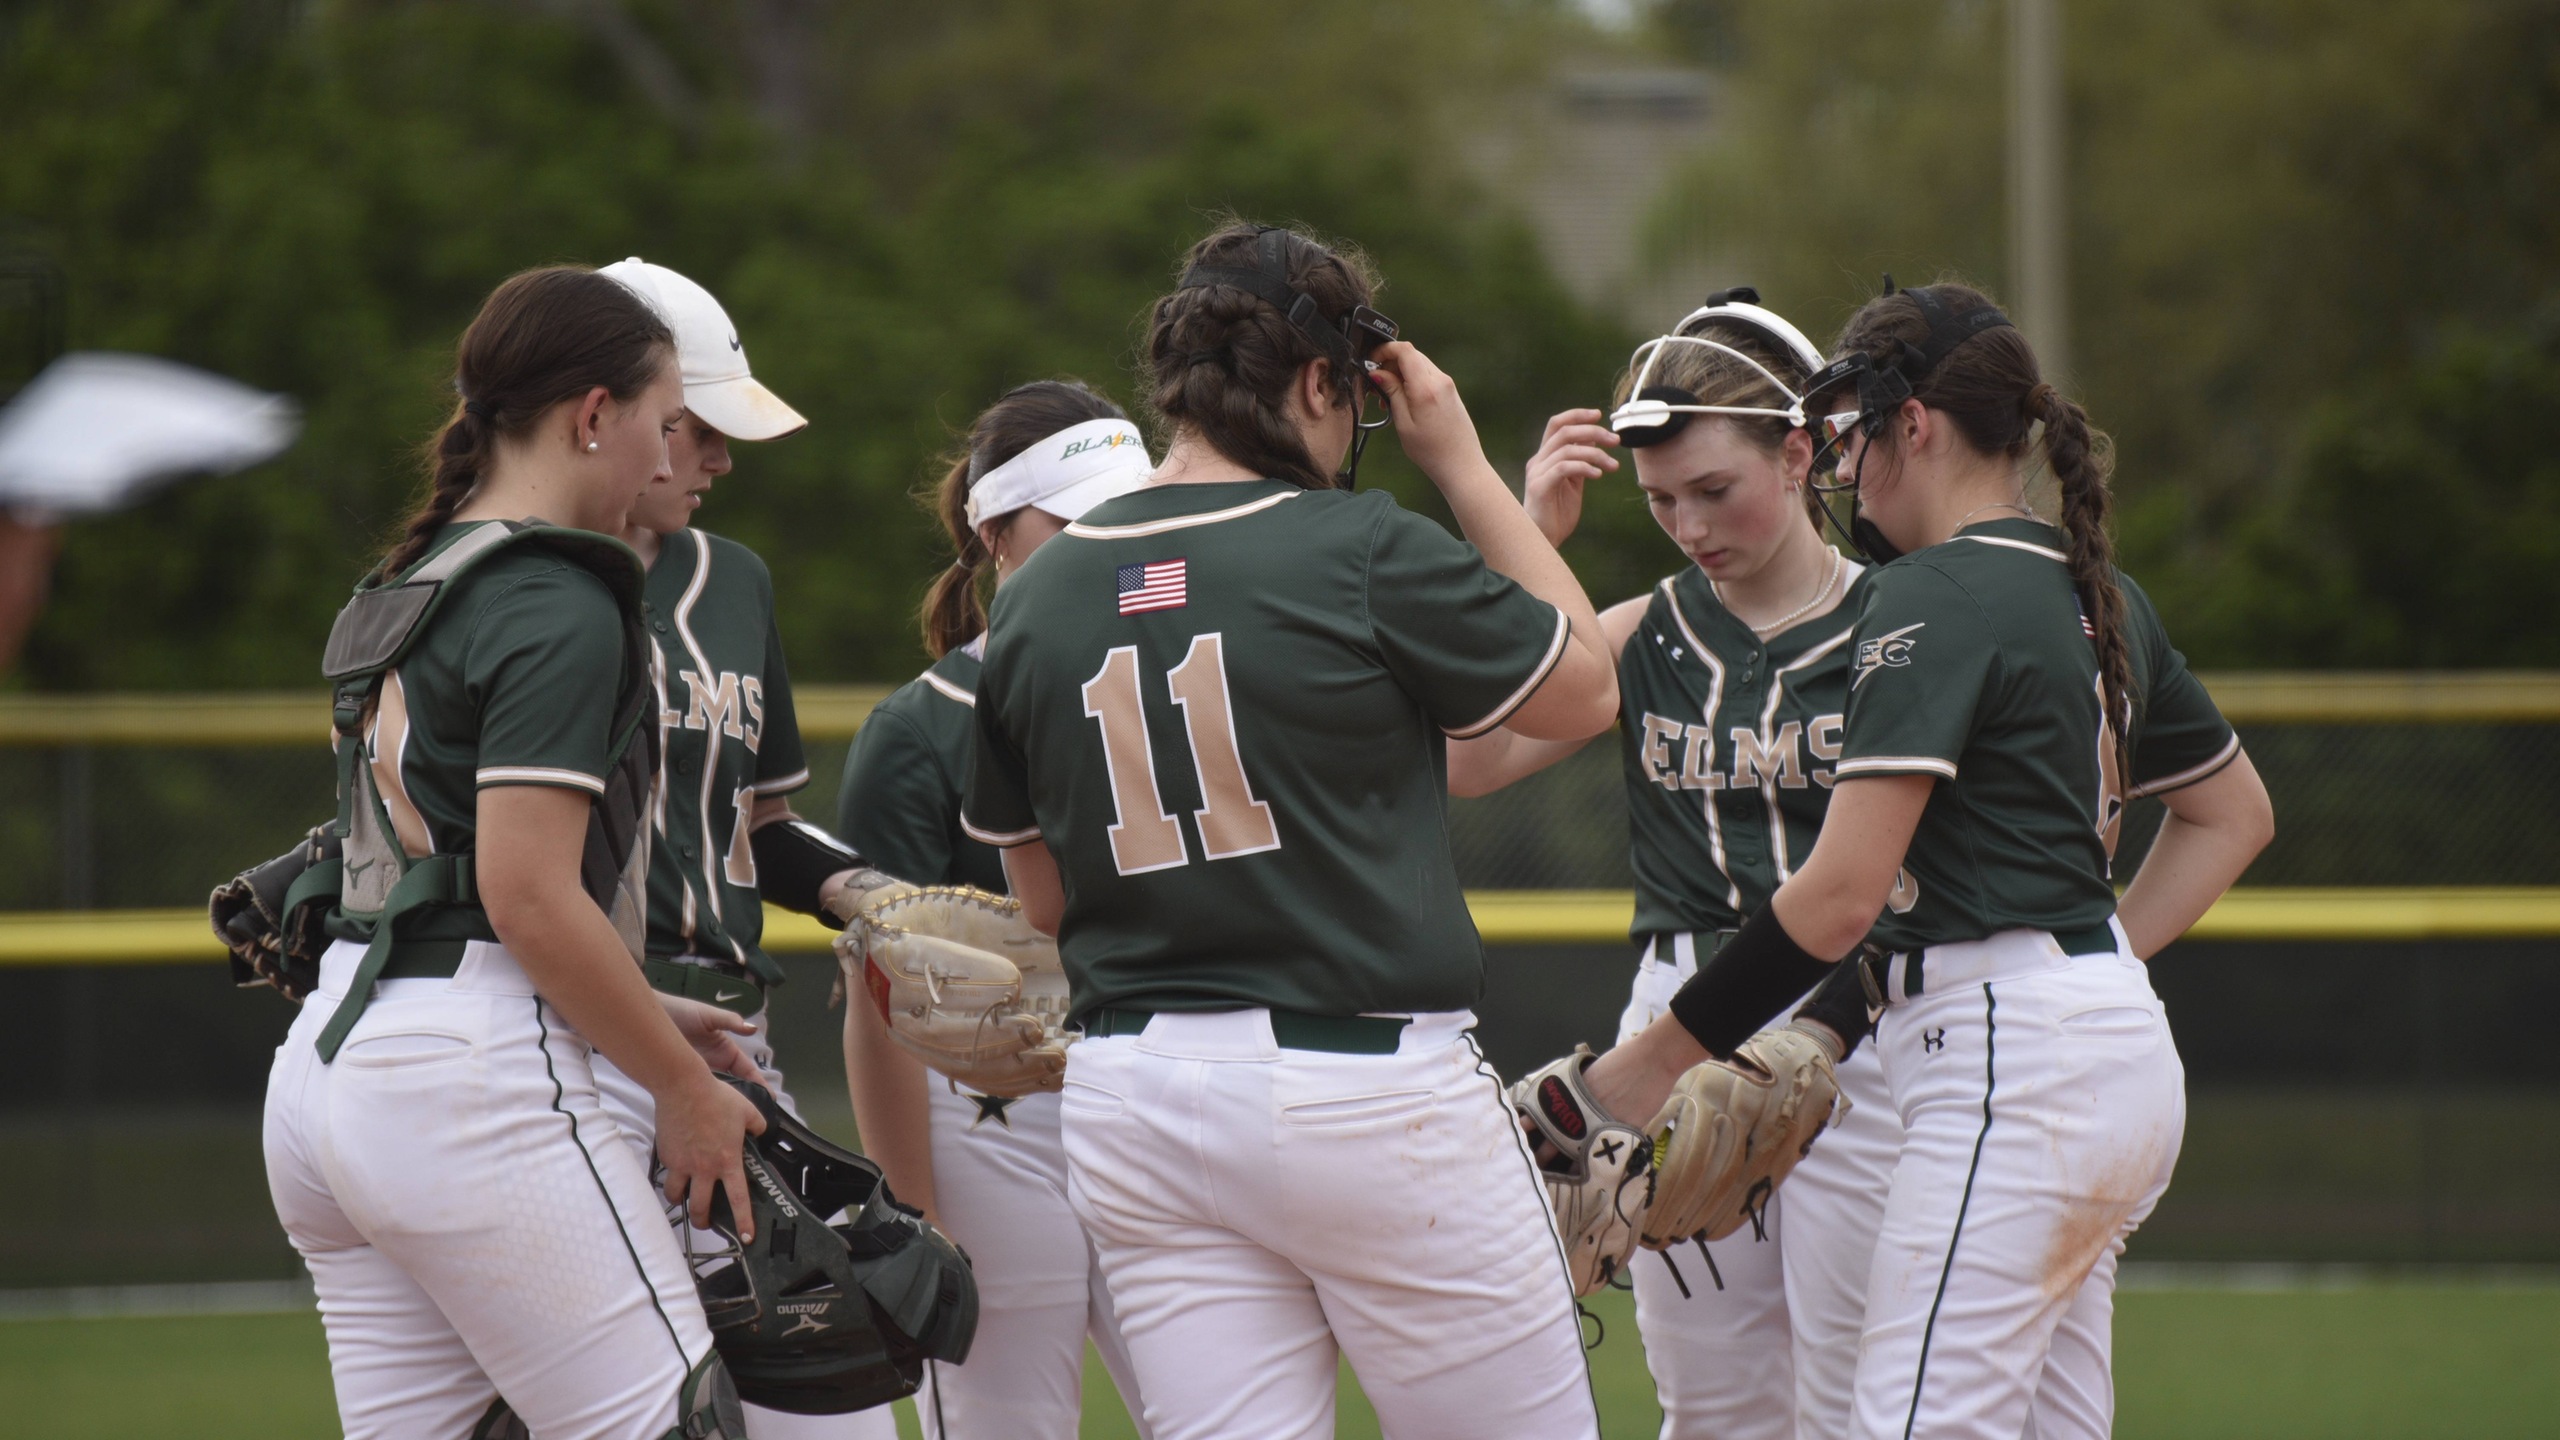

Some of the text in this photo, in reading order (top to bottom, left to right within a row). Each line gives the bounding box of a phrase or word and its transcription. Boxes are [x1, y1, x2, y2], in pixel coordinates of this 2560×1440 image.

[1856, 638, 1916, 669] EC
[648, 662, 763, 756] LMS
[1641, 711, 1844, 791] ELMS
[1081, 632, 1281, 876] 11
